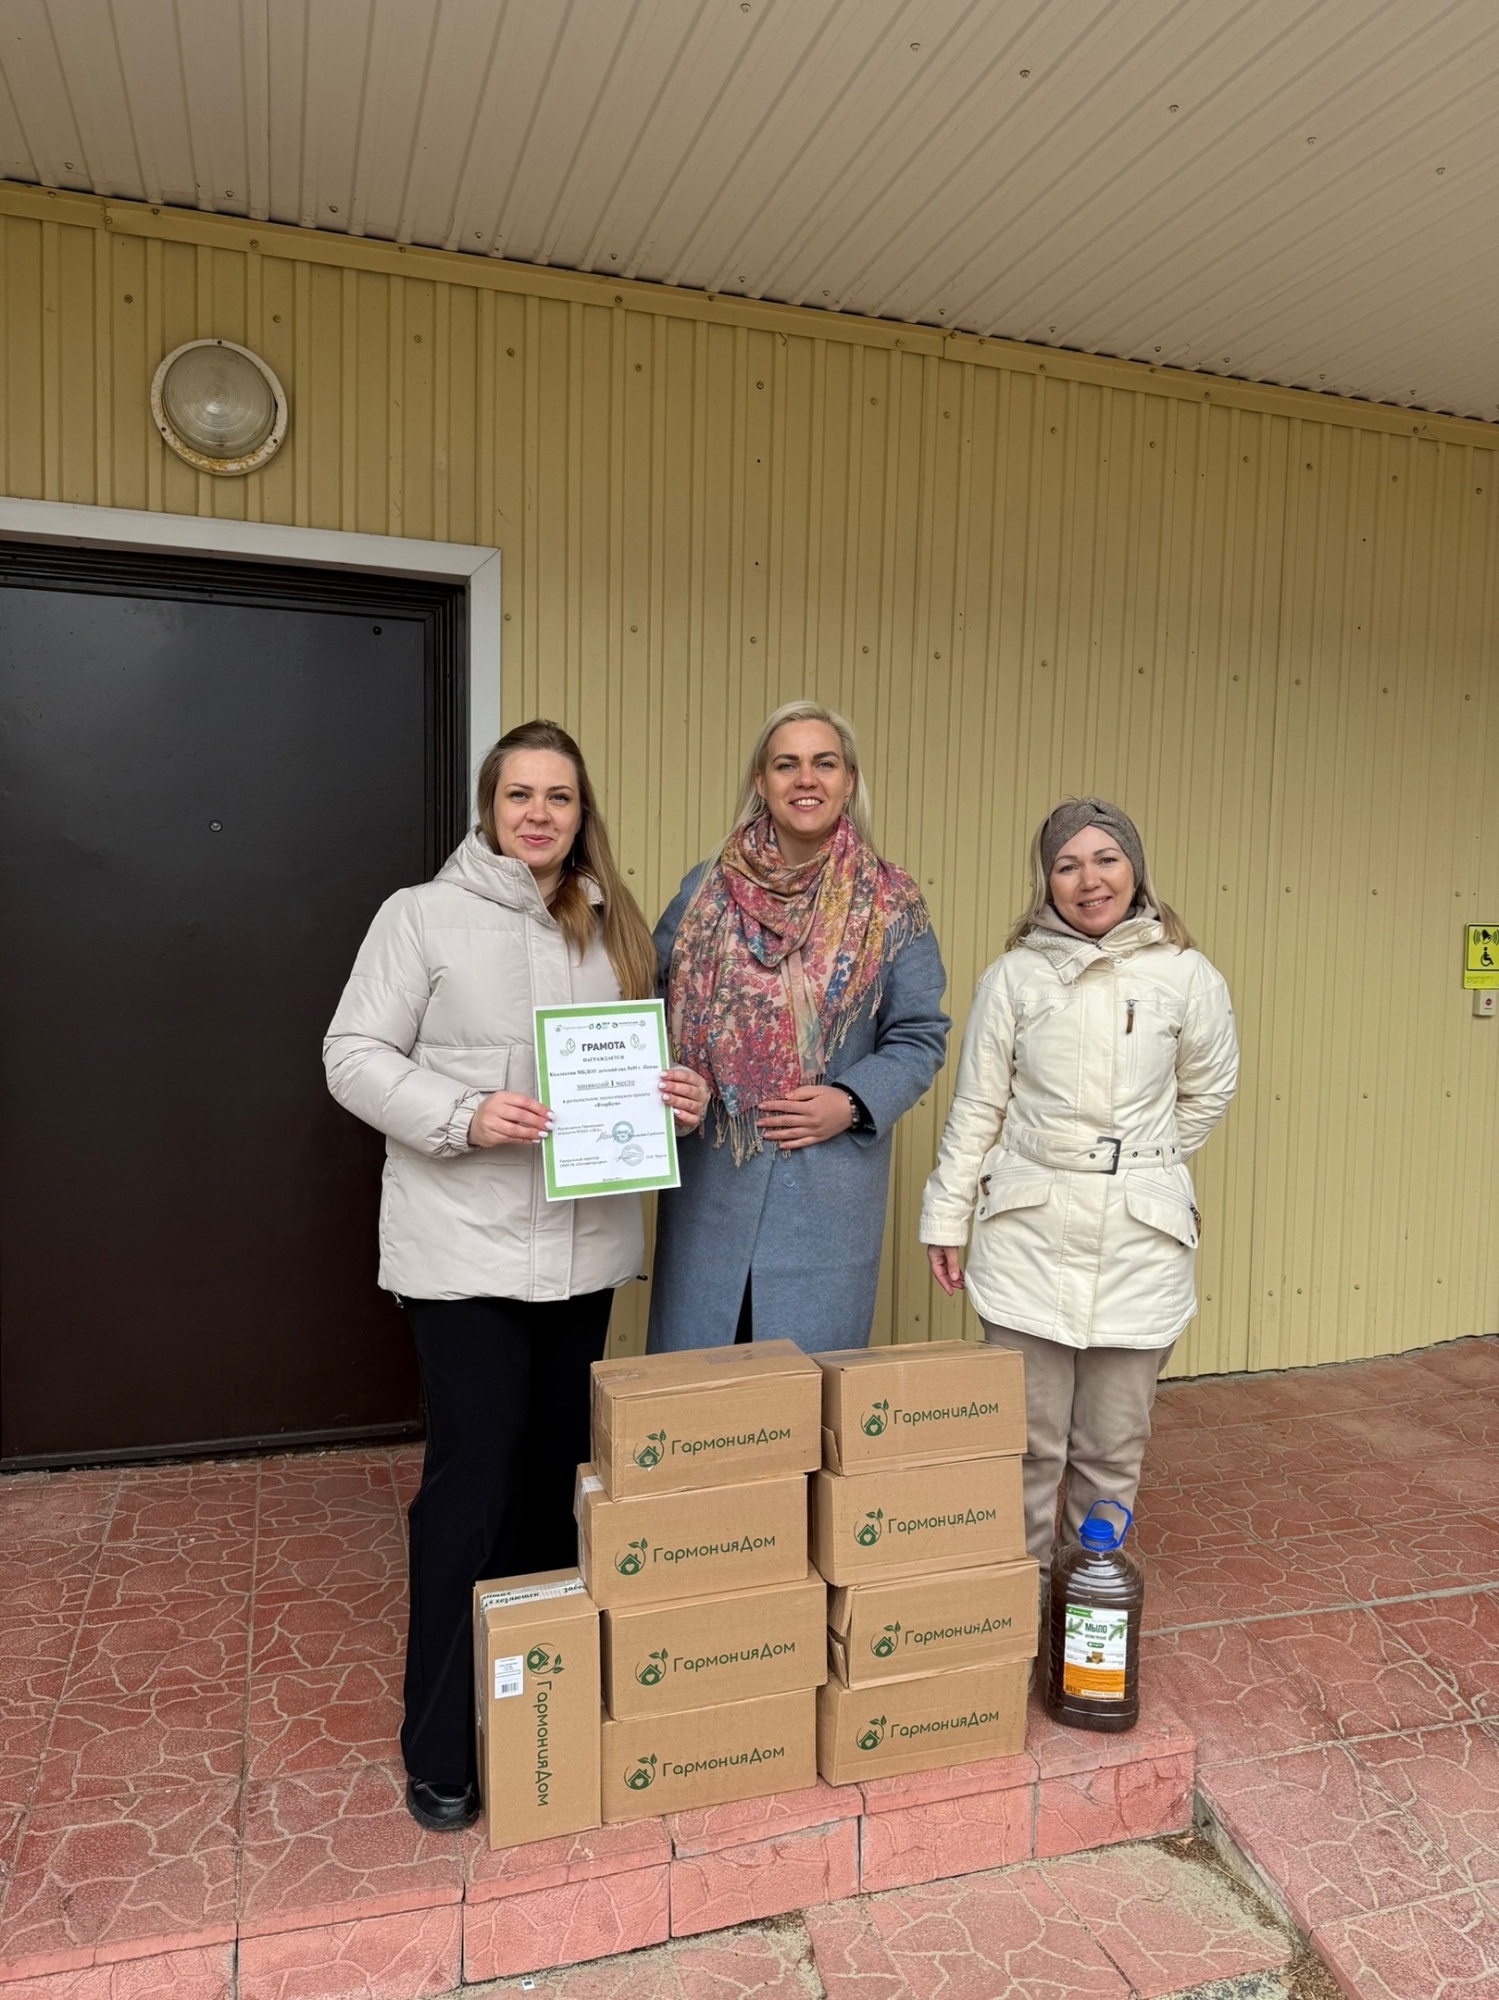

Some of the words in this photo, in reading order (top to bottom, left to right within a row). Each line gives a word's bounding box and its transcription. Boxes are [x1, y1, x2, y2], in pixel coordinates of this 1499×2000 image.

[582, 1041, 626, 1052] ГРАМОТА
[894, 1401, 999, 1426] ГармонияДом
[671, 1428, 791, 1455] ГармонияДом
[889, 1508, 996, 1534] ГармонияДом
[653, 1535, 776, 1563] ГармонияДом
[904, 1617, 1012, 1645] ГармонияДом
[1085, 1622, 1107, 1634] МЫЛО
[673, 1641, 796, 1672] ГармонияДом
[890, 1711, 999, 1738] ГармонияДом
[532, 1680, 553, 1807] ГармонияДом
[662, 1746, 785, 1778] ГармонияДом
